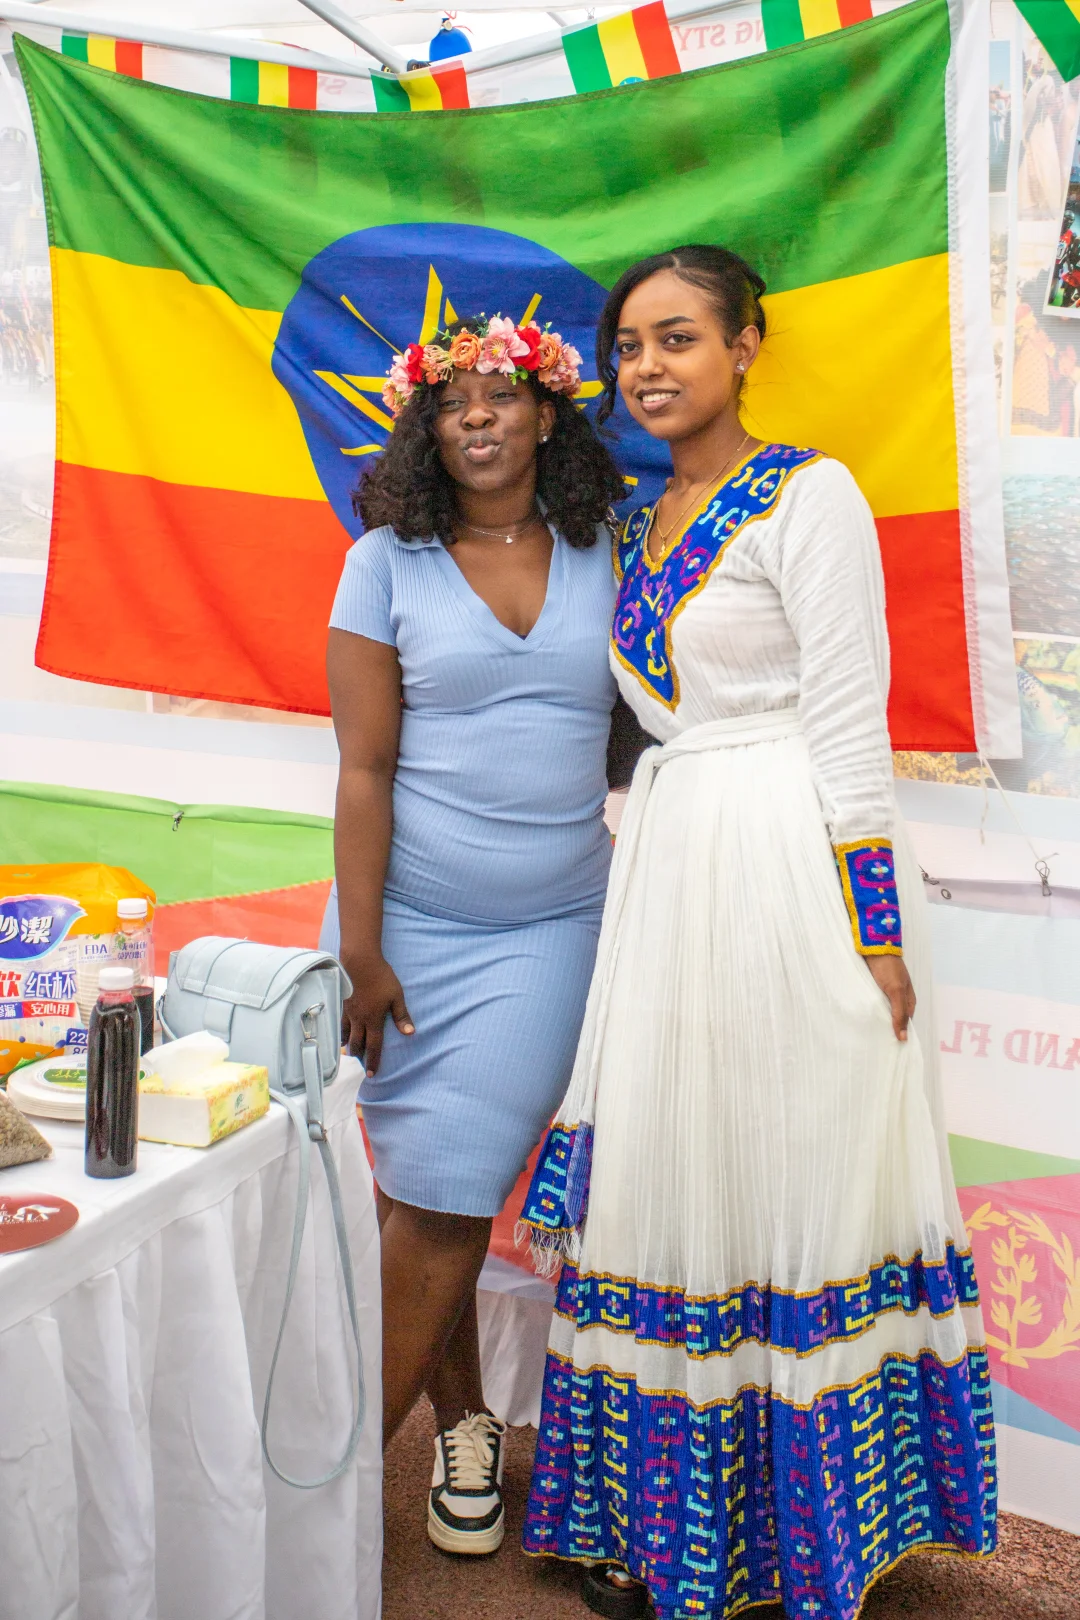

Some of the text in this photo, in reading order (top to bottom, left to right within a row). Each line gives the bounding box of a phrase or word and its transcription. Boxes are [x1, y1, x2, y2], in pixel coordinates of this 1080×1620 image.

[84, 943, 108, 955] FDA
[31, 1003, 70, 1016] 安心用
